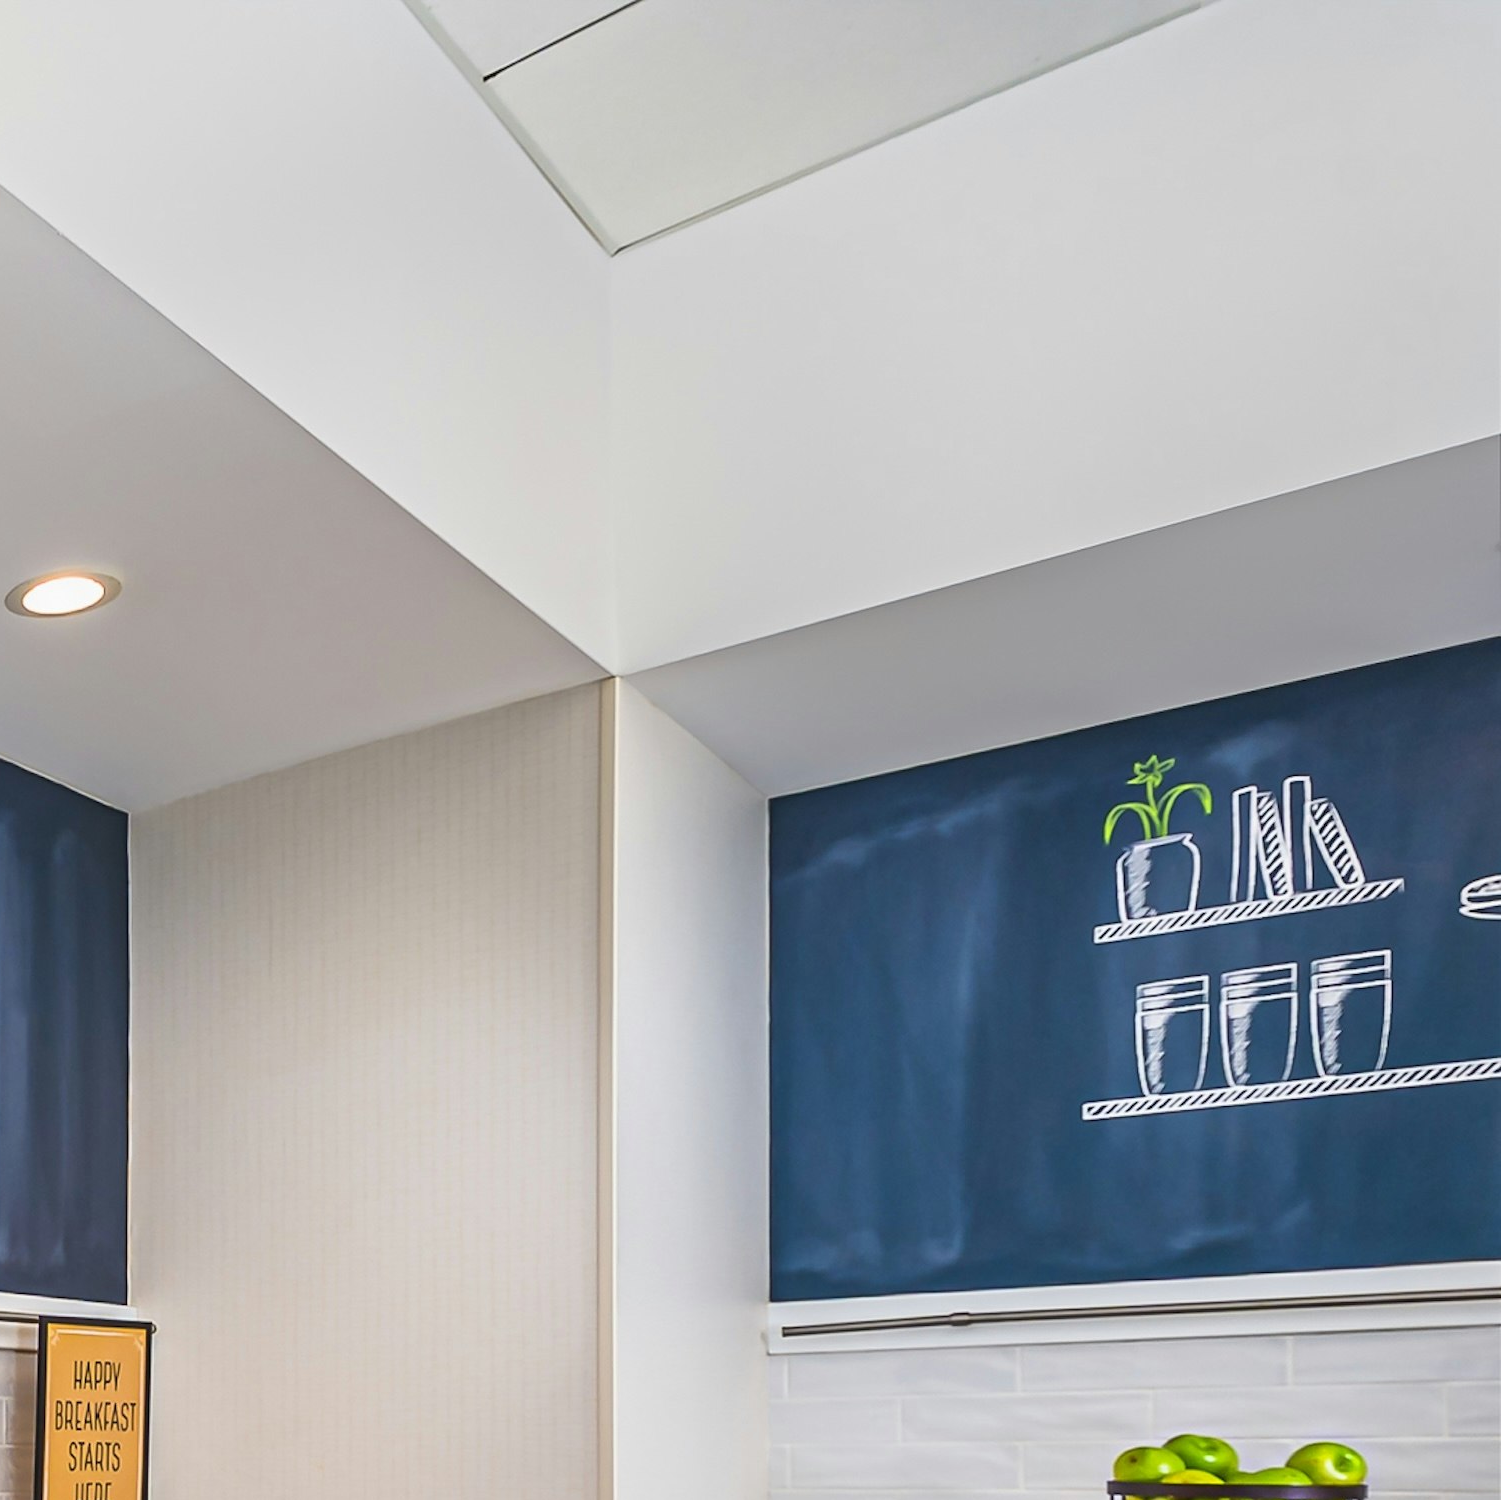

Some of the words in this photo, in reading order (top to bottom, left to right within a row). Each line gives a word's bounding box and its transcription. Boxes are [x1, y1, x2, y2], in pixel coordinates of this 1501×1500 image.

[73, 1360, 121, 1391] HAPPY
[55, 1400, 136, 1432] BREAKFAST
[69, 1441, 121, 1472] STARTS
